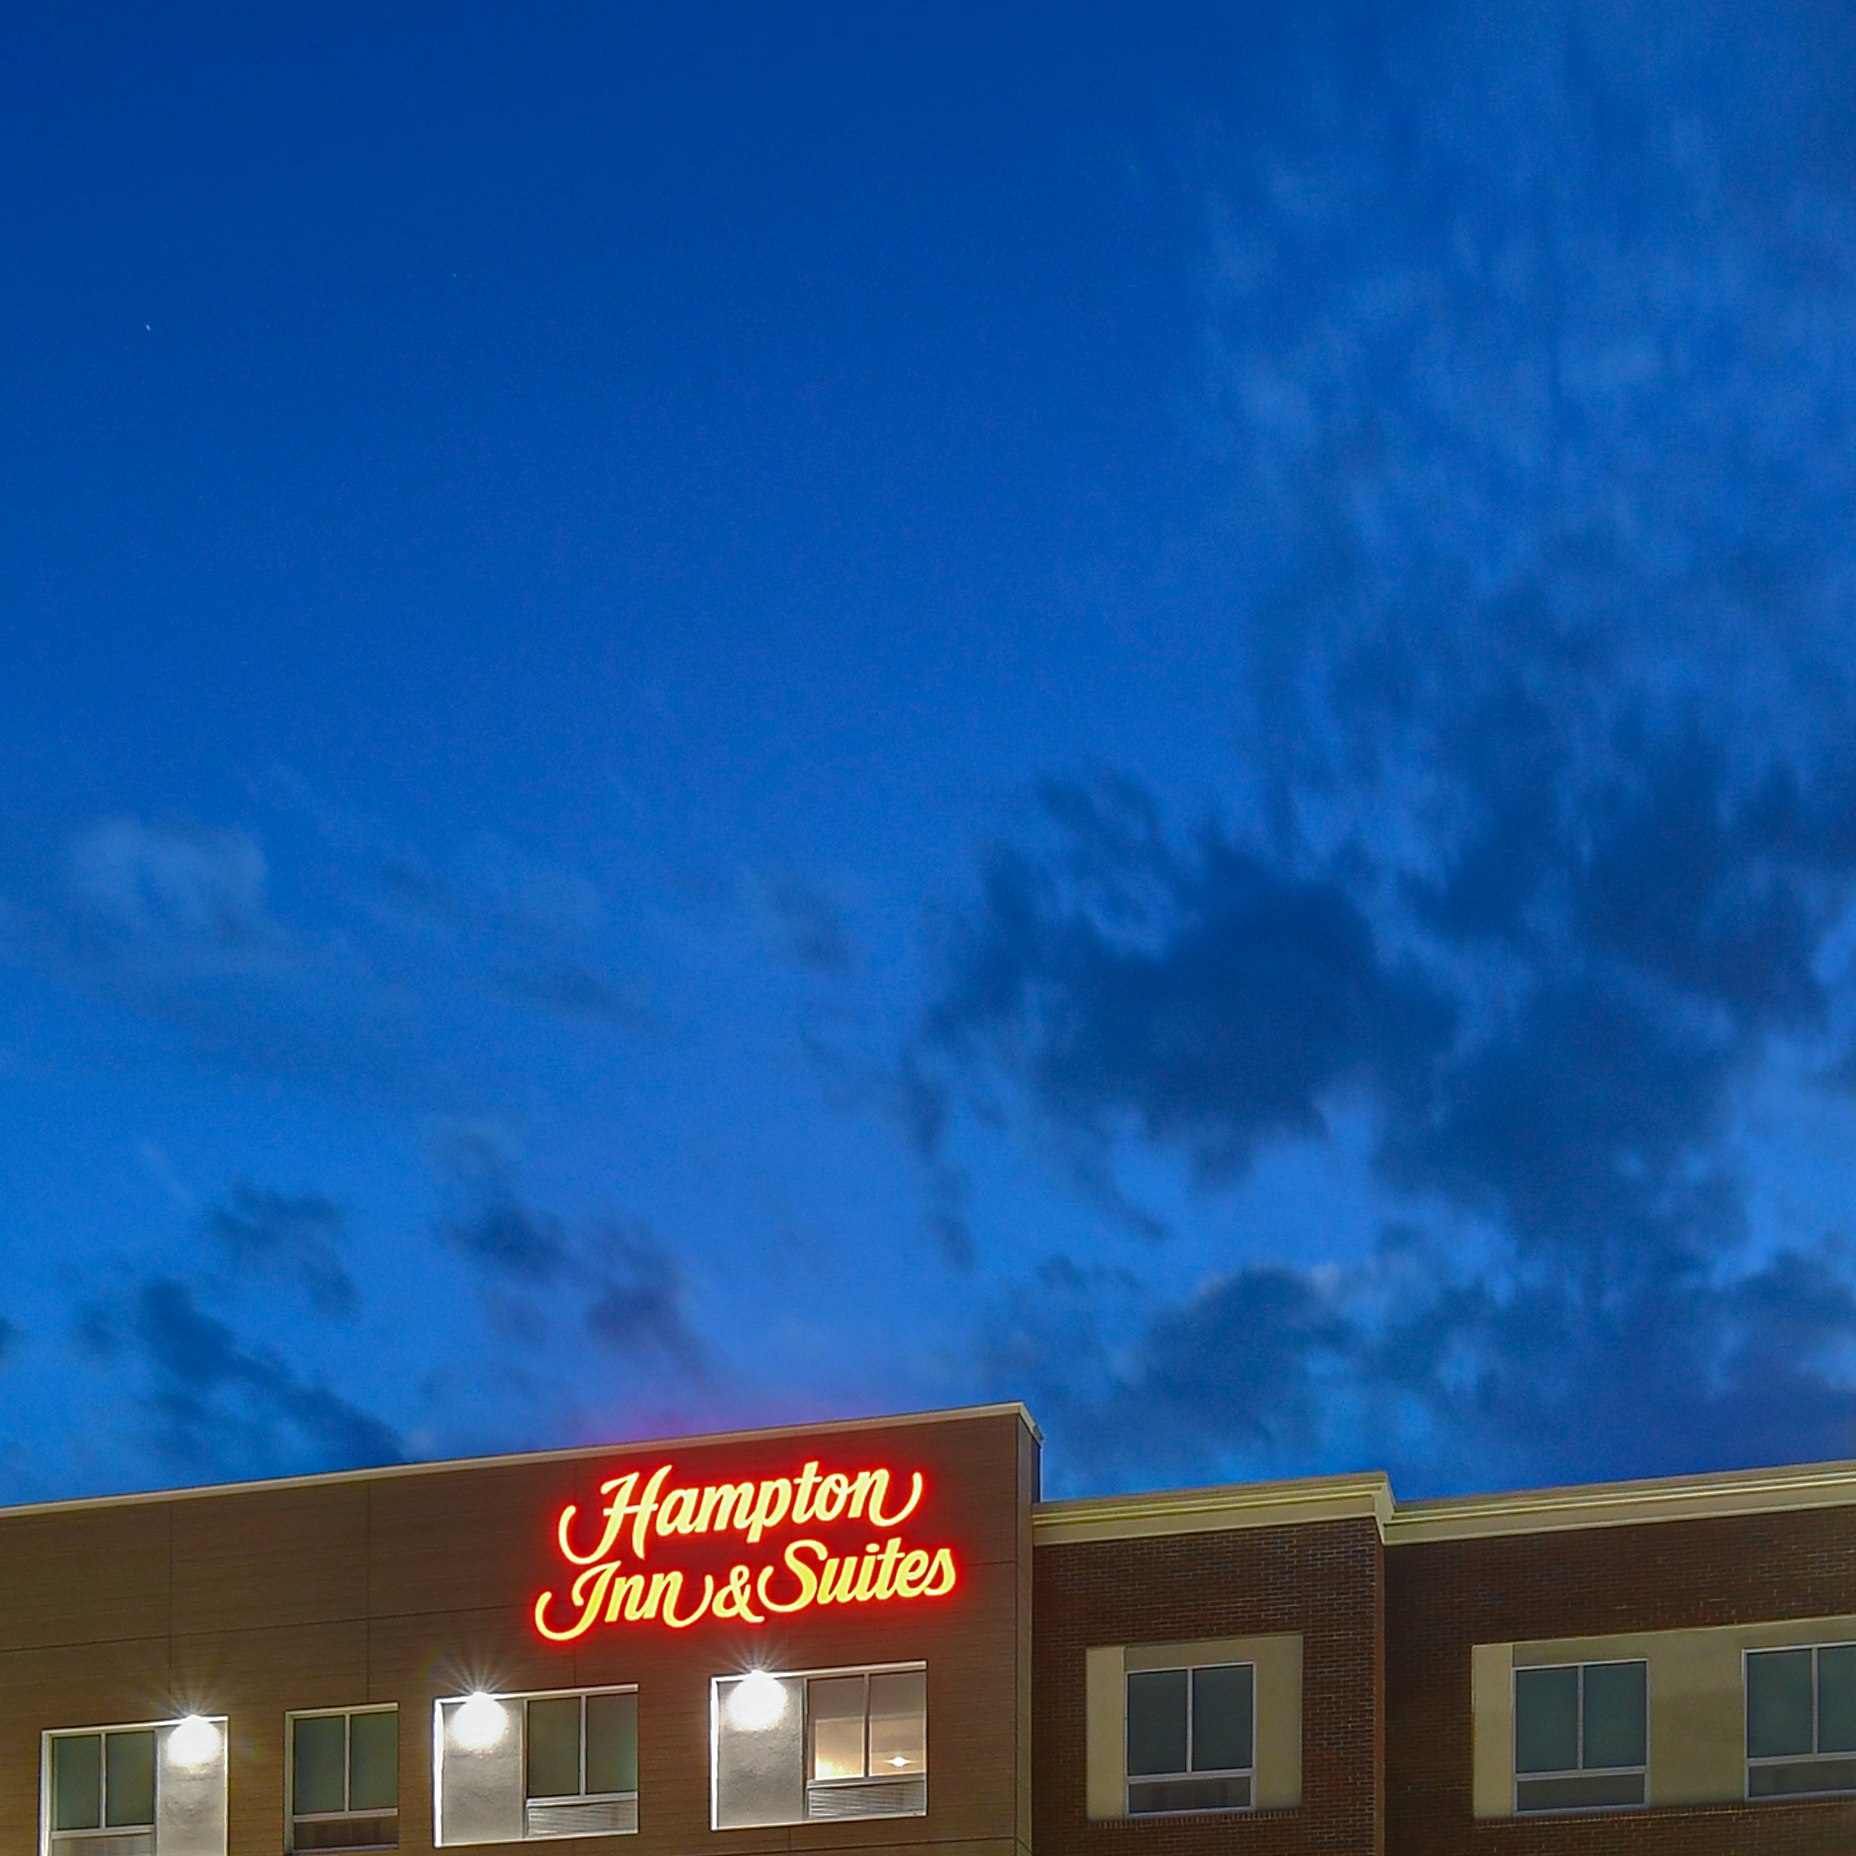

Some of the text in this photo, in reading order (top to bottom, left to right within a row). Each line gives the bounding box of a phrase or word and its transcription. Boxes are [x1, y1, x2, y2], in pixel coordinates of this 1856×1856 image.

[558, 1460, 924, 1565] Hampton
[534, 1536, 957, 1641] Inn & Suites
